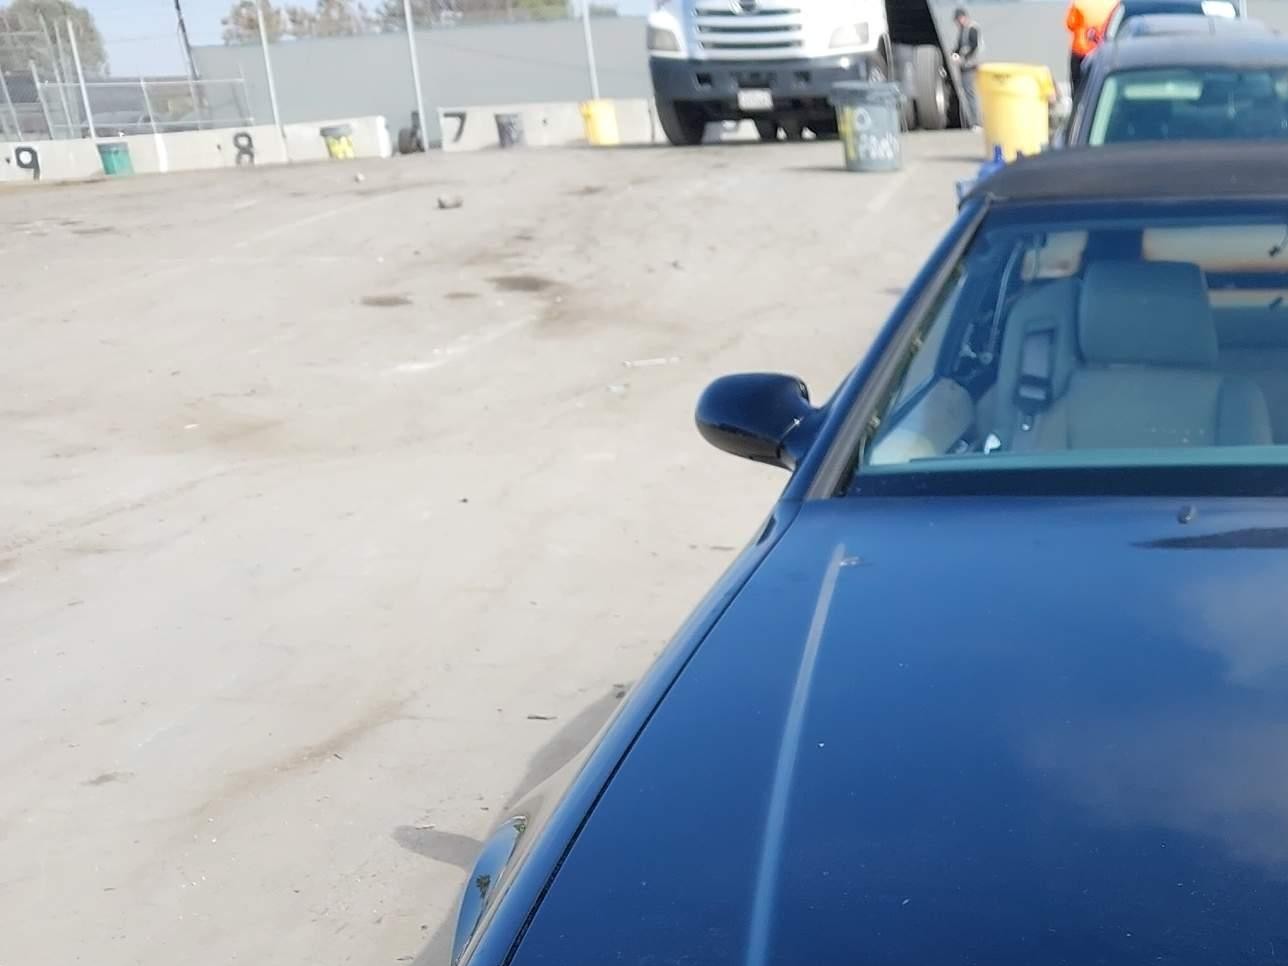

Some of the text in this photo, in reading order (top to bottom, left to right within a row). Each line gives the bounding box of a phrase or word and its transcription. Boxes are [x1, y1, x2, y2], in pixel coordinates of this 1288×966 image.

[443, 112, 466, 143] 7
[15, 146, 40, 180] 9
[233, 132, 254, 166] 8
